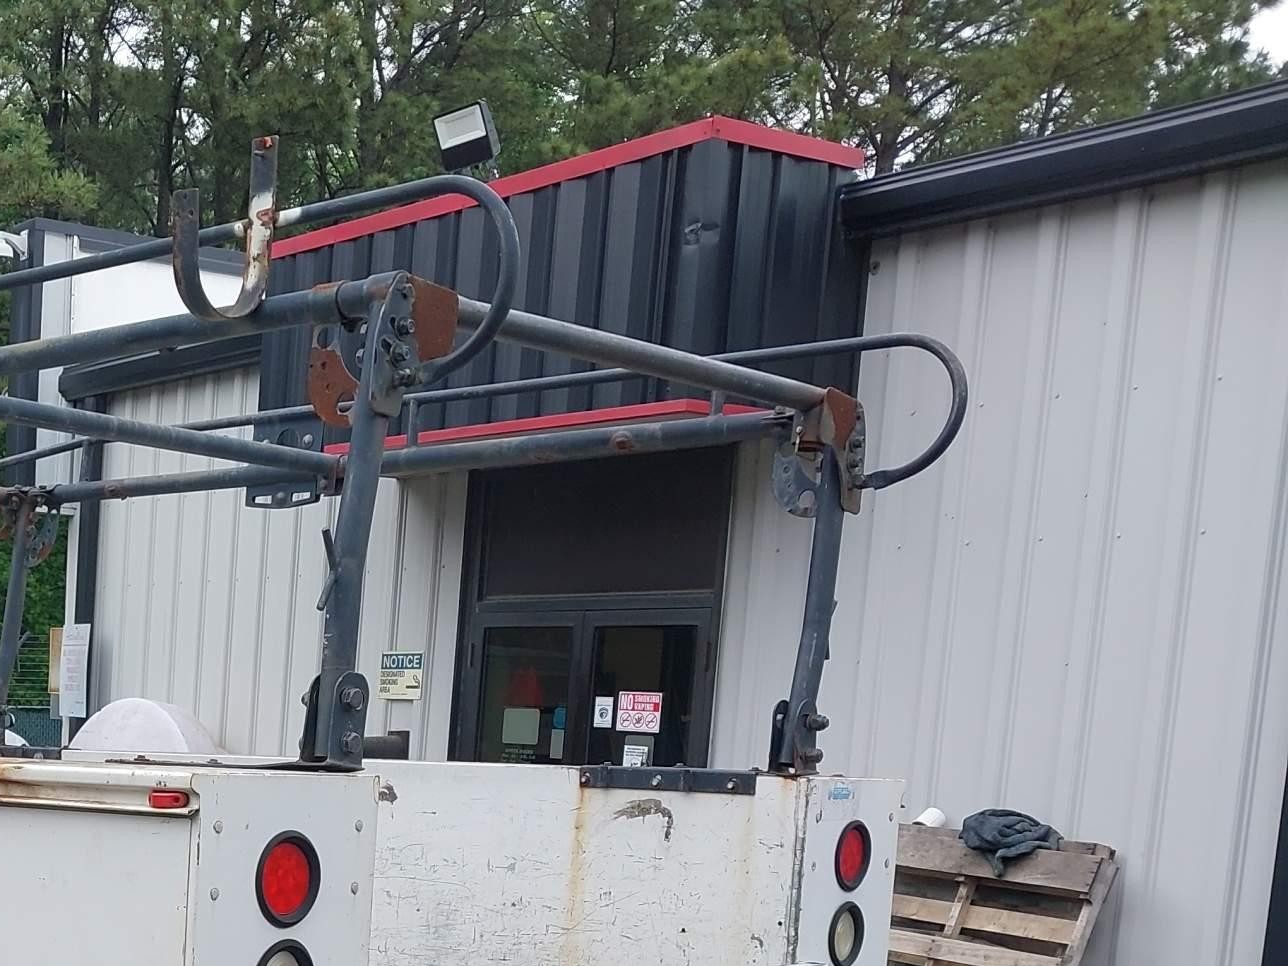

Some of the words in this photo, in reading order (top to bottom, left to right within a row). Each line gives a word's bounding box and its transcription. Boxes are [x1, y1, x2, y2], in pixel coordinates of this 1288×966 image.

[383, 655, 420, 668] NOTICE
[621, 694, 633, 710] NO
[634, 695, 660, 703] SMOKING
[634, 703, 654, 711] VAPING
